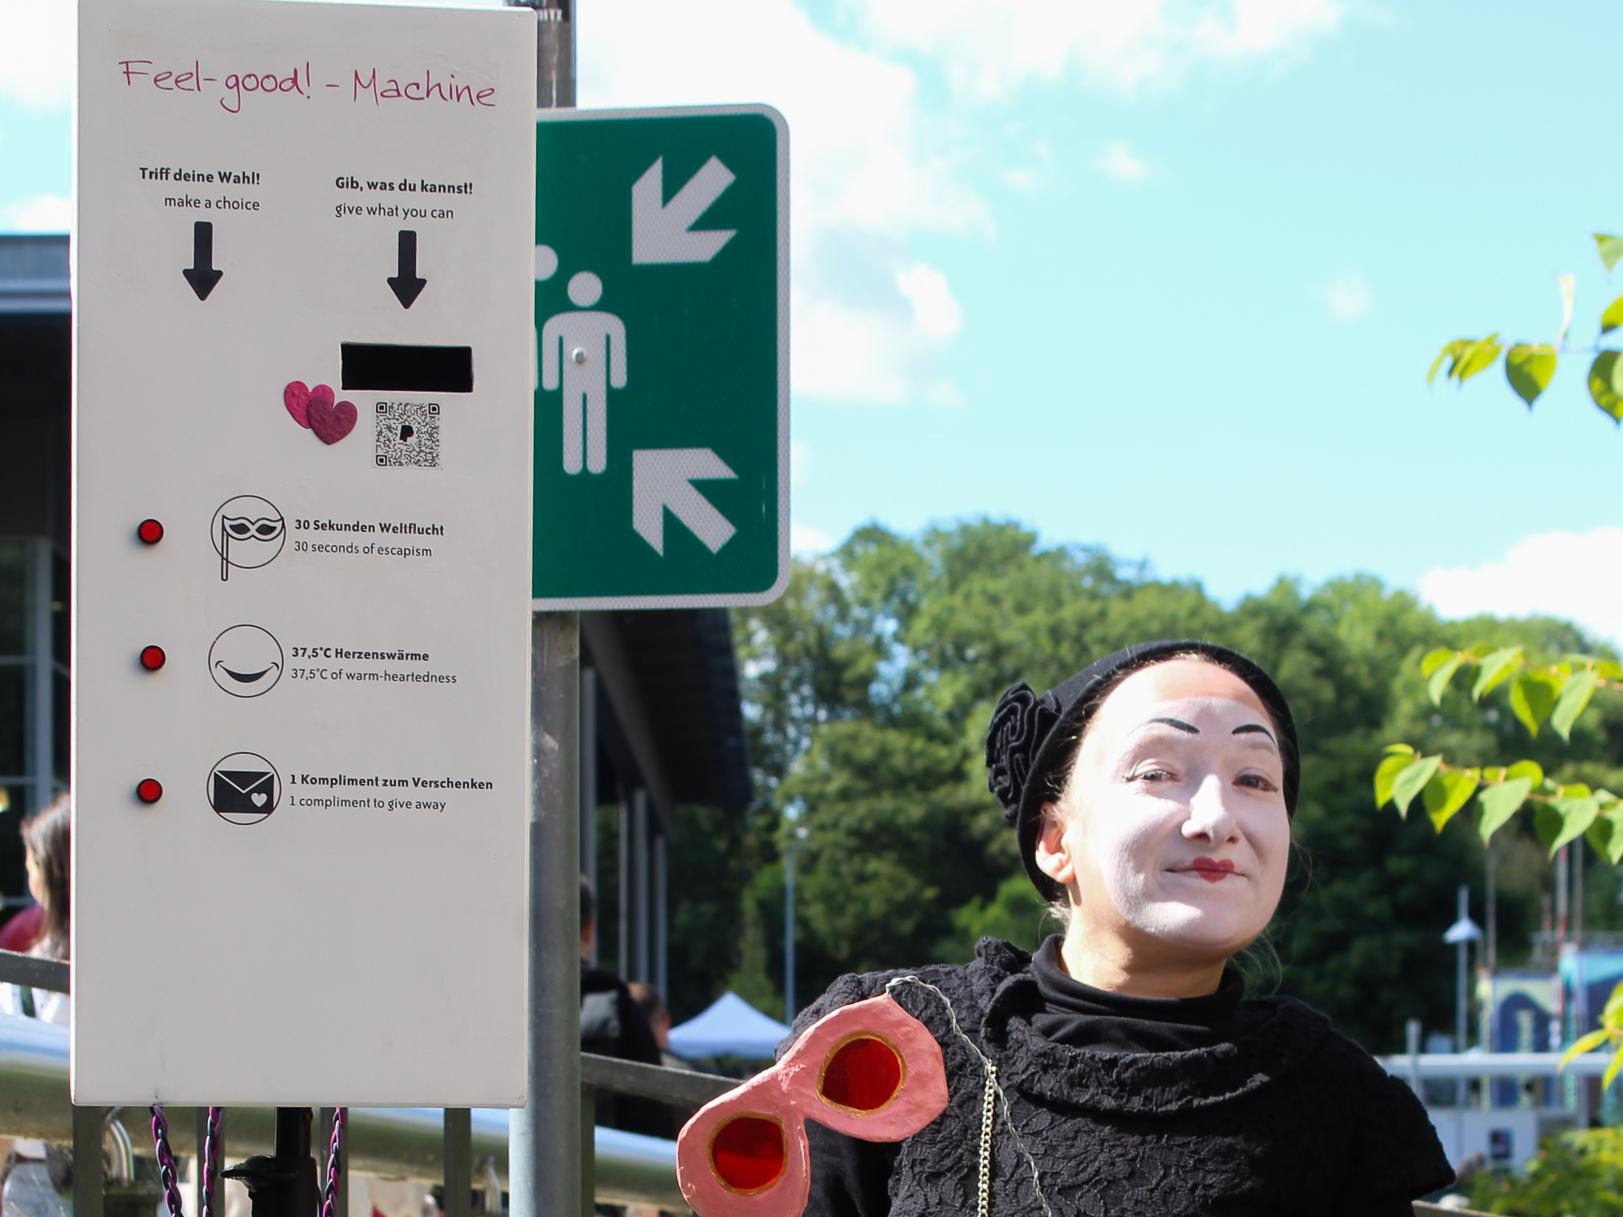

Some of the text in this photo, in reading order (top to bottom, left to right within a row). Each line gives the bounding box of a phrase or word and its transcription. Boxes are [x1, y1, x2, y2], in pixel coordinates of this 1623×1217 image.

[117, 59, 311, 114] Feel-good!
[353, 67, 496, 107] Machine
[138, 166, 261, 186] Triff deine Wahl!
[335, 175, 473, 196] Gib, was du kannst!
[164, 193, 261, 211] make a choice
[334, 202, 454, 221] give what you can
[294, 518, 445, 537] 30 Sekunden Weltflucht
[293, 540, 432, 559] 30 seconds of escapism
[334, 647, 430, 662] Herzenswärme
[330, 668, 344, 681] of
[345, 669, 457, 684] warm-heartedness
[289, 773, 493, 790] 1 Kompliment zum Verschenken
[289, 795, 447, 813] 1 compliment to give away
